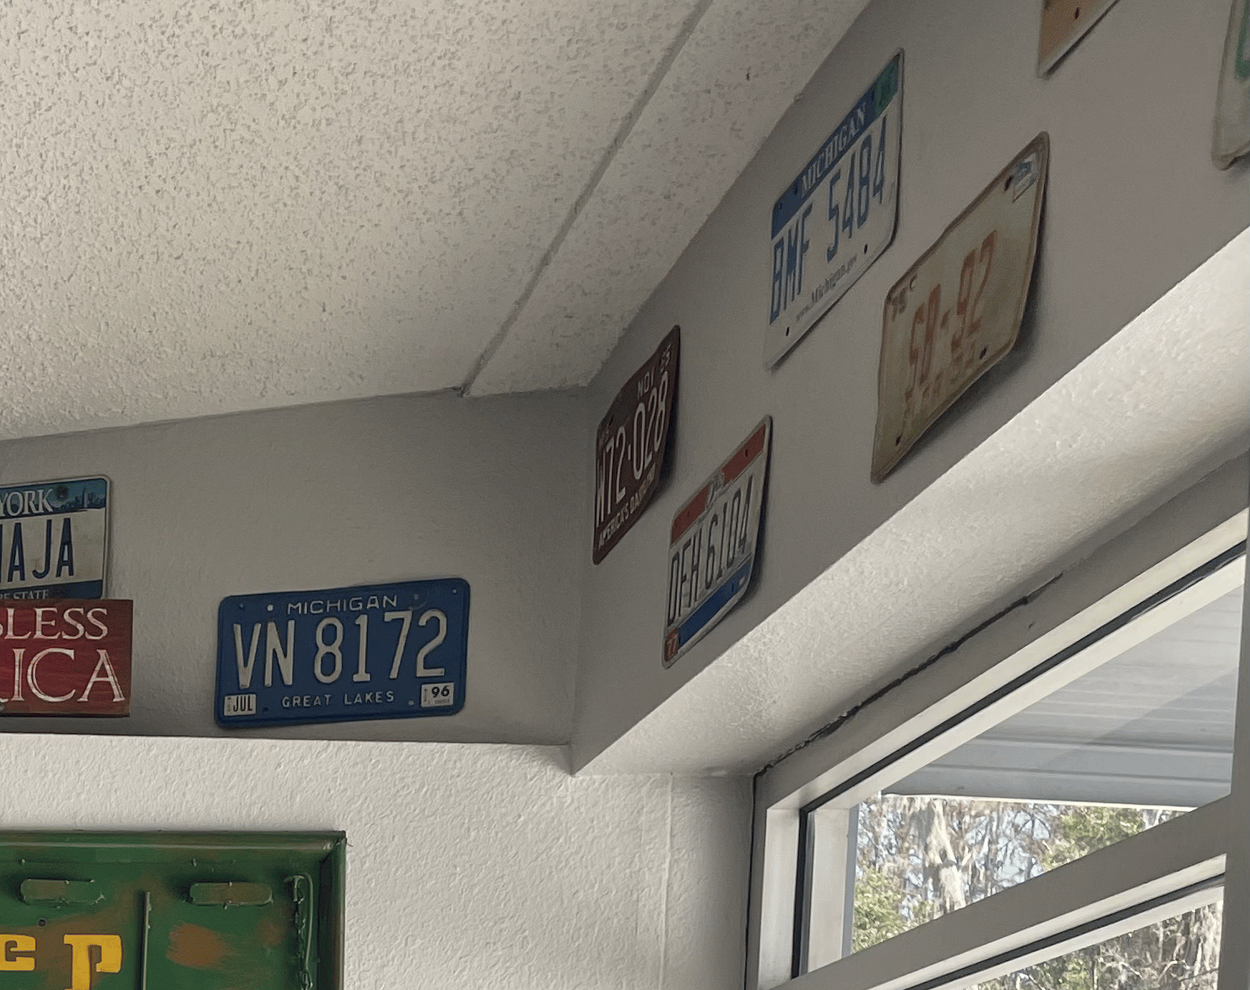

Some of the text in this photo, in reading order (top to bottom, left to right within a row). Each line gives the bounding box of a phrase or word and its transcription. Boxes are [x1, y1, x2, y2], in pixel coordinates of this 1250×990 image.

[801, 100, 867, 198] MICHIGAN
[769, 114, 887, 325] BMF 5484
[704, 474, 753, 591] 6104
[287, 594, 398, 615] MICHIGAN
[233, 608, 448, 690] VN 8172
[232, 694, 253, 712] JUL
[282, 690, 395, 708] GREAT LAKES
[431, 685, 450, 698] 96
